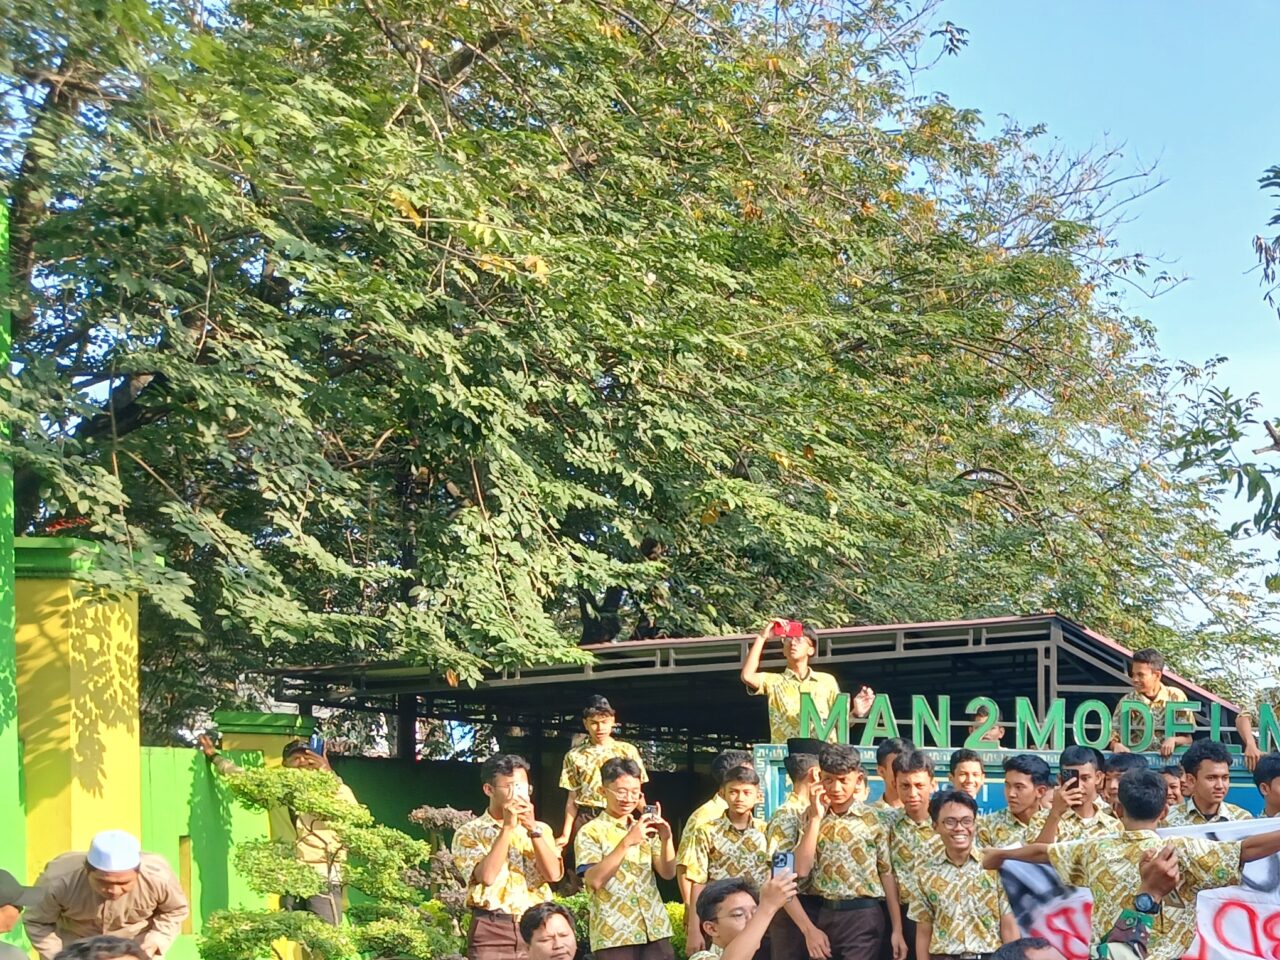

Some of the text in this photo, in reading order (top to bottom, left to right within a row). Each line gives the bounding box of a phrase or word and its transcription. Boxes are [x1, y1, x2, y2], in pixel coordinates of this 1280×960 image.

[800, 692, 951, 748] MAN
[963, 696, 1000, 750] 2
[1015, 697, 1243, 753] MODEL
